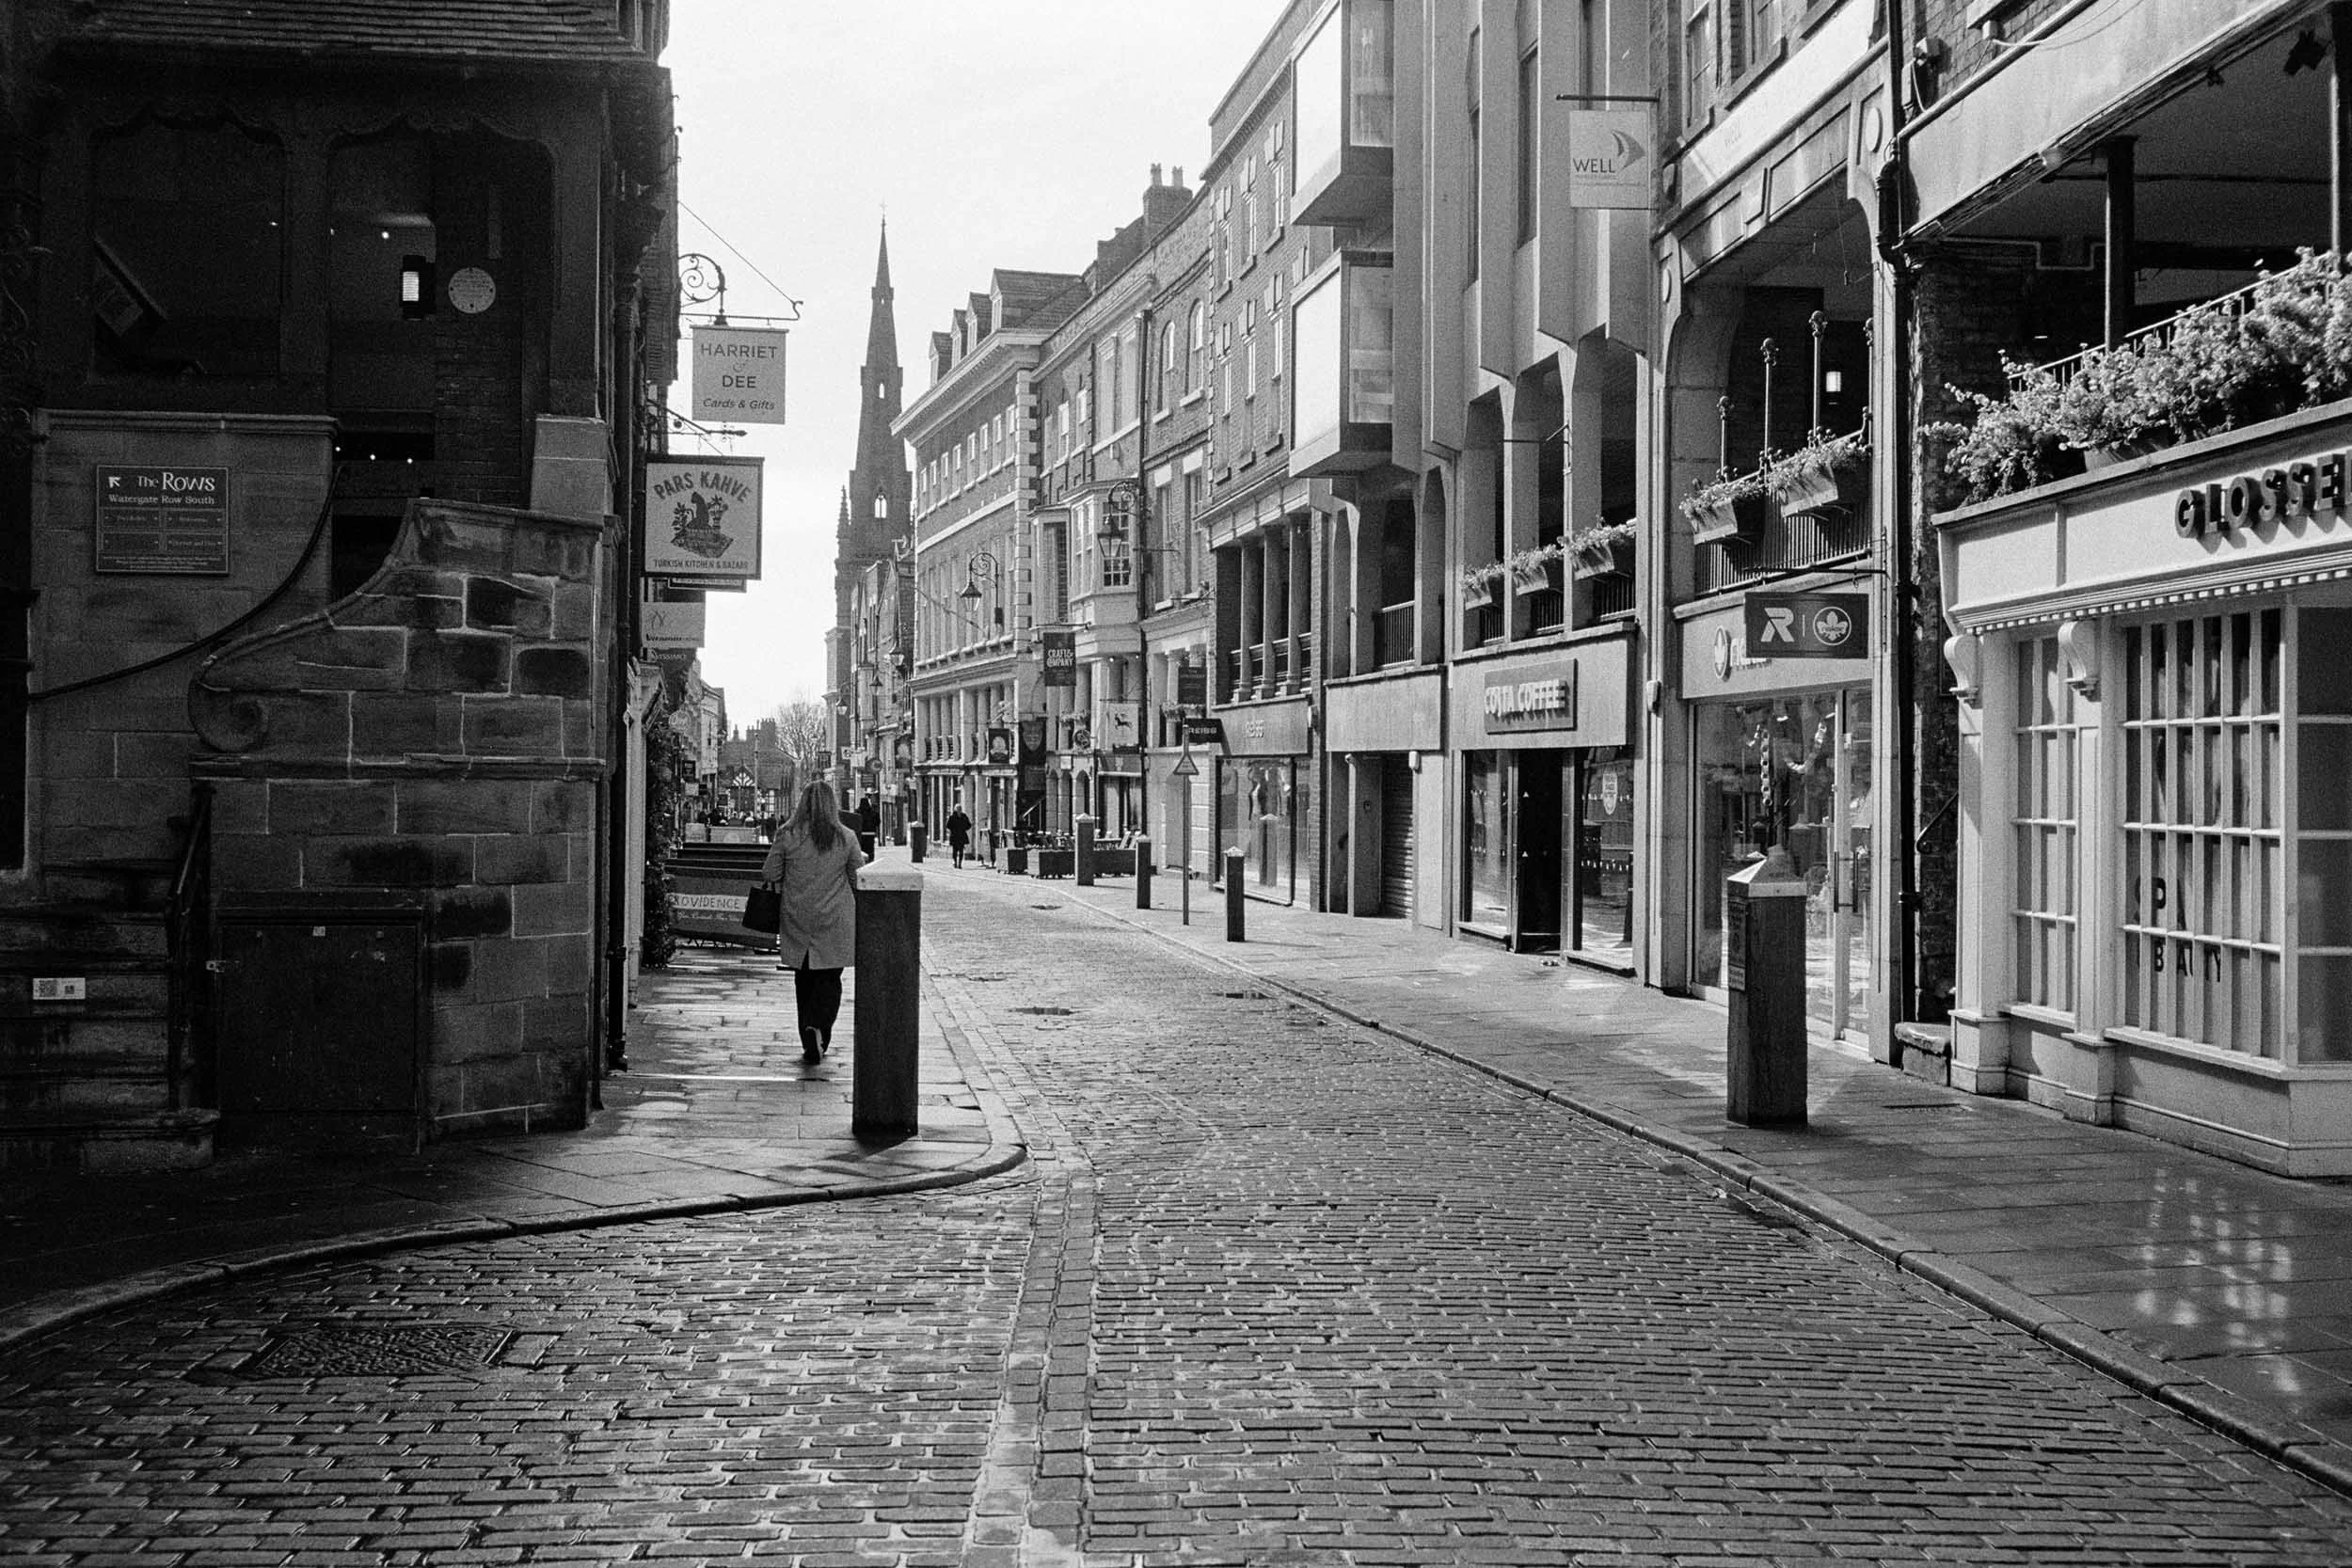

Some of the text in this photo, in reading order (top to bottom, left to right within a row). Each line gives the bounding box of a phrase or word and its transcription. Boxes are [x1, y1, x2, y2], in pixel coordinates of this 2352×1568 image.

[1572, 158, 1616, 173] WELL
[700, 343, 778, 358] HARRIET
[722, 375, 756, 388] DEE
[703, 398, 774, 411] Cards & Gifts
[137, 476, 159, 487] The
[653, 471, 752, 502] PARS KAHVE
[108, 494, 215, 505] Watergate Row South
[654, 559, 683, 568] TURKISH
[685, 560, 714, 569] KITCHEN
[1485, 678, 1565, 717] COSTA COFFEE
